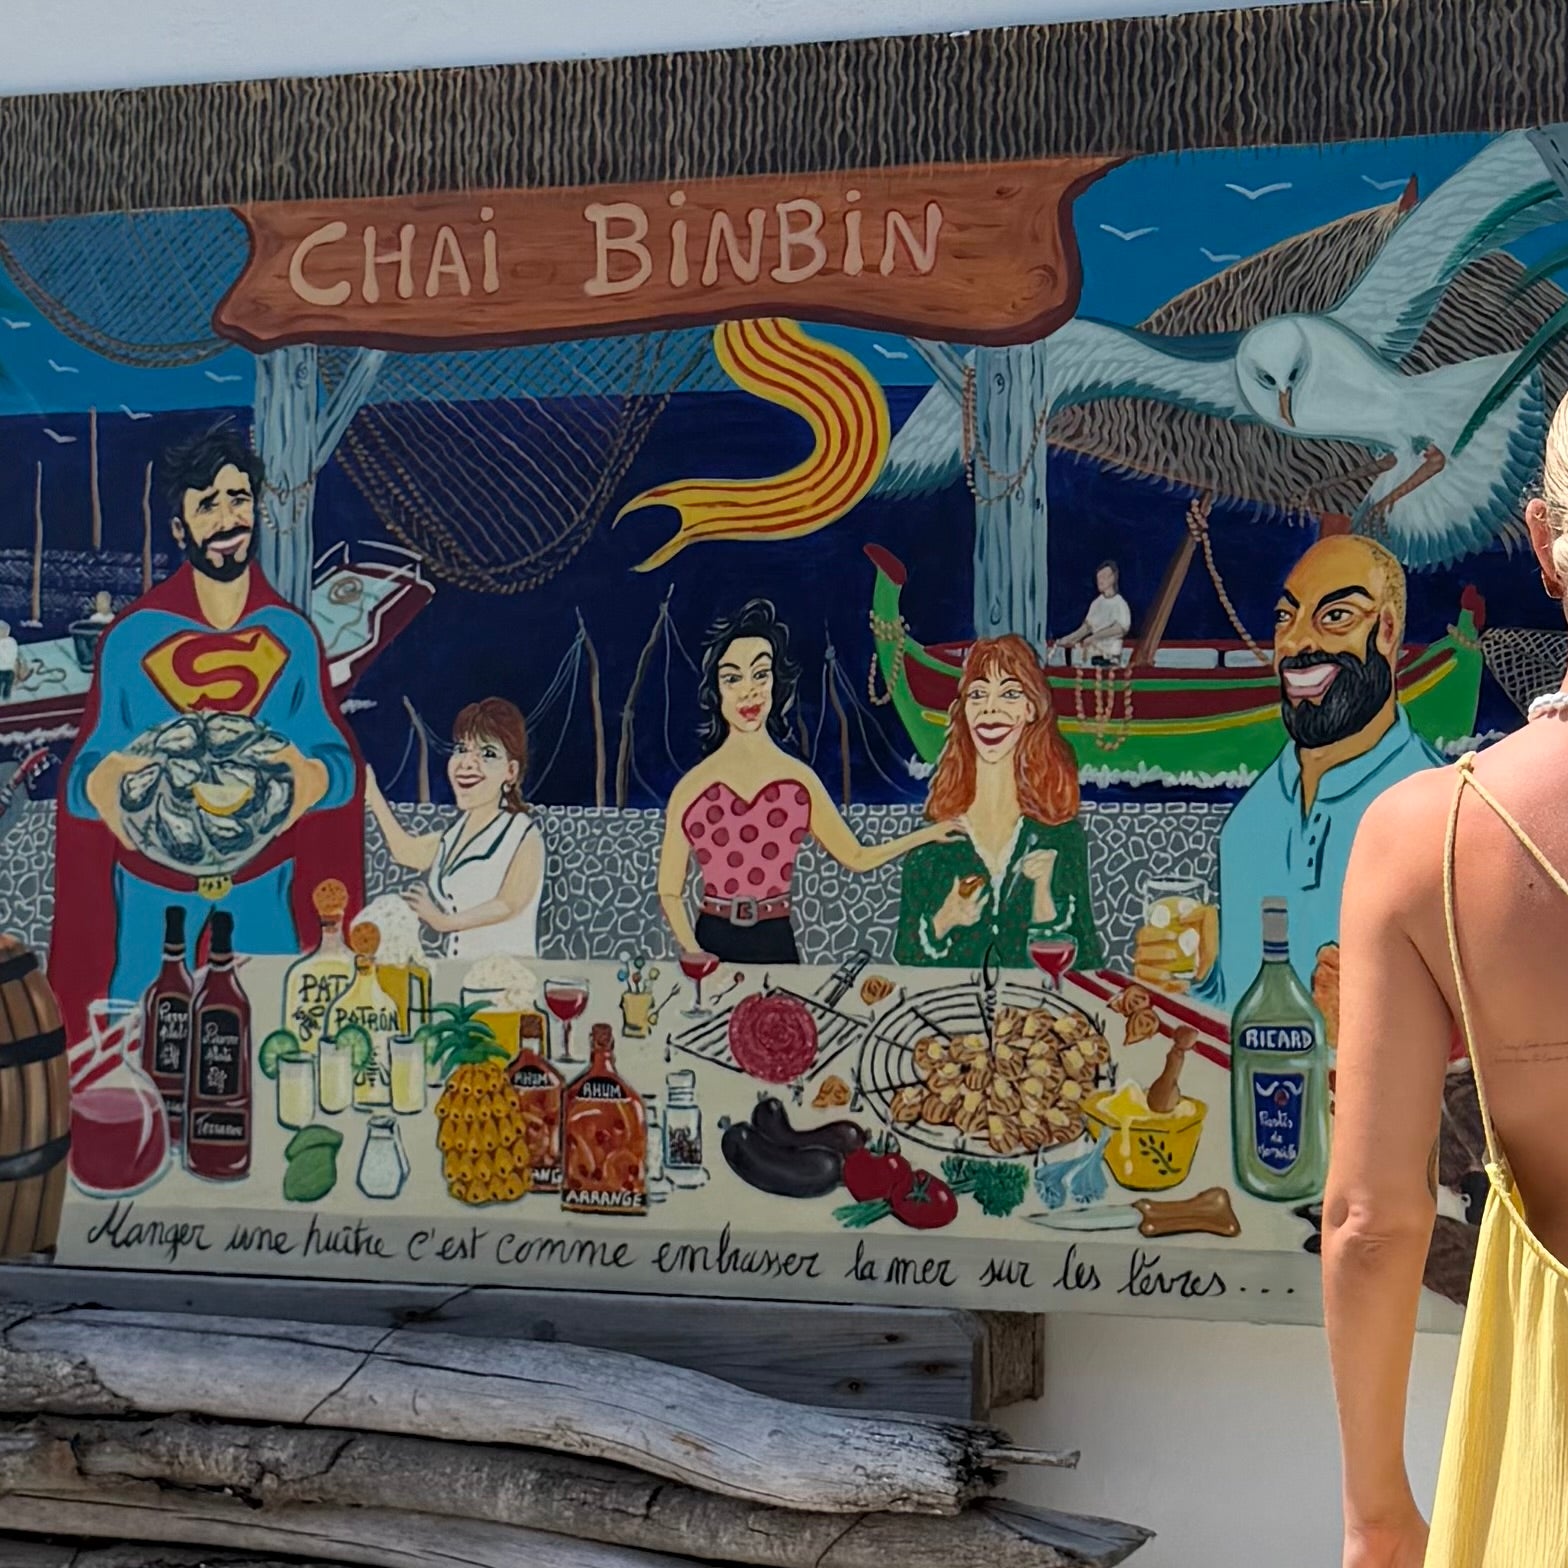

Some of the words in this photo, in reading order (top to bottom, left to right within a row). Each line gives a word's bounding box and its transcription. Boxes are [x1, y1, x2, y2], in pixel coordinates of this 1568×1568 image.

[299, 974, 348, 1003] PAT
[1245, 1028, 1313, 1049] RICARD
[582, 1082, 622, 1098] RHUM
[88, 1200, 212, 1263] Manger
[225, 1223, 296, 1255] une
[651, 1222, 821, 1279] embrasser
[979, 1260, 1035, 1288] sur
[1053, 1243, 1101, 1291] les
